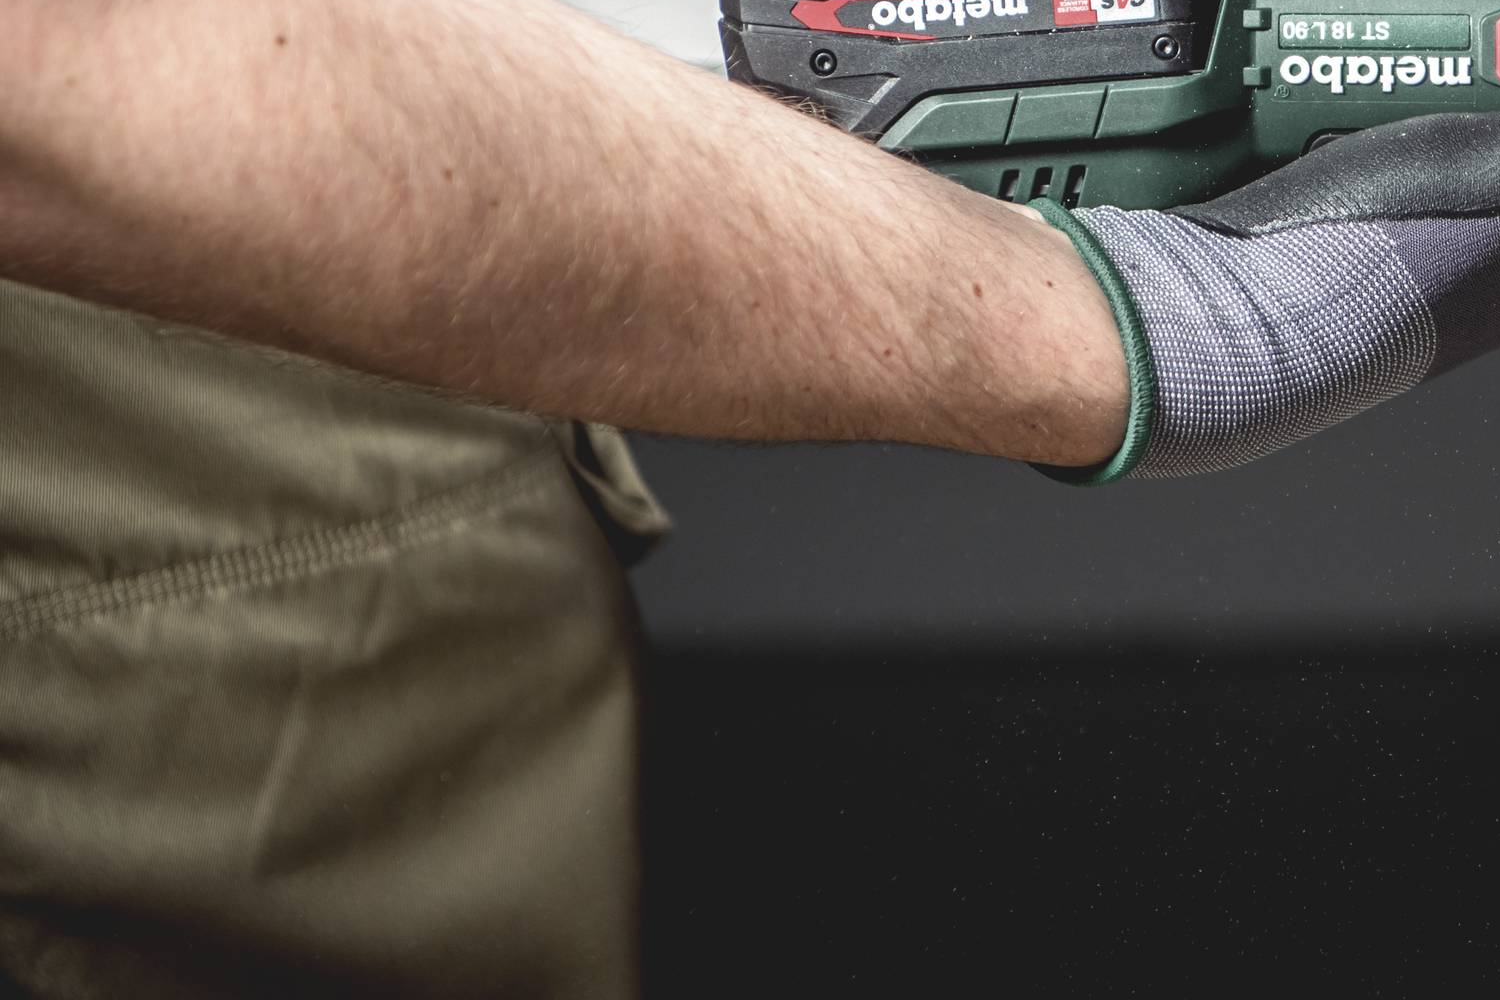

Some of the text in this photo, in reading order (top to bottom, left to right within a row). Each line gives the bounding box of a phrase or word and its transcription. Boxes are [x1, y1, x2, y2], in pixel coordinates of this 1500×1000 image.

[1283, 21, 1390, 40] ST 18 L 90
[1280, 55, 1472, 94] metabo
